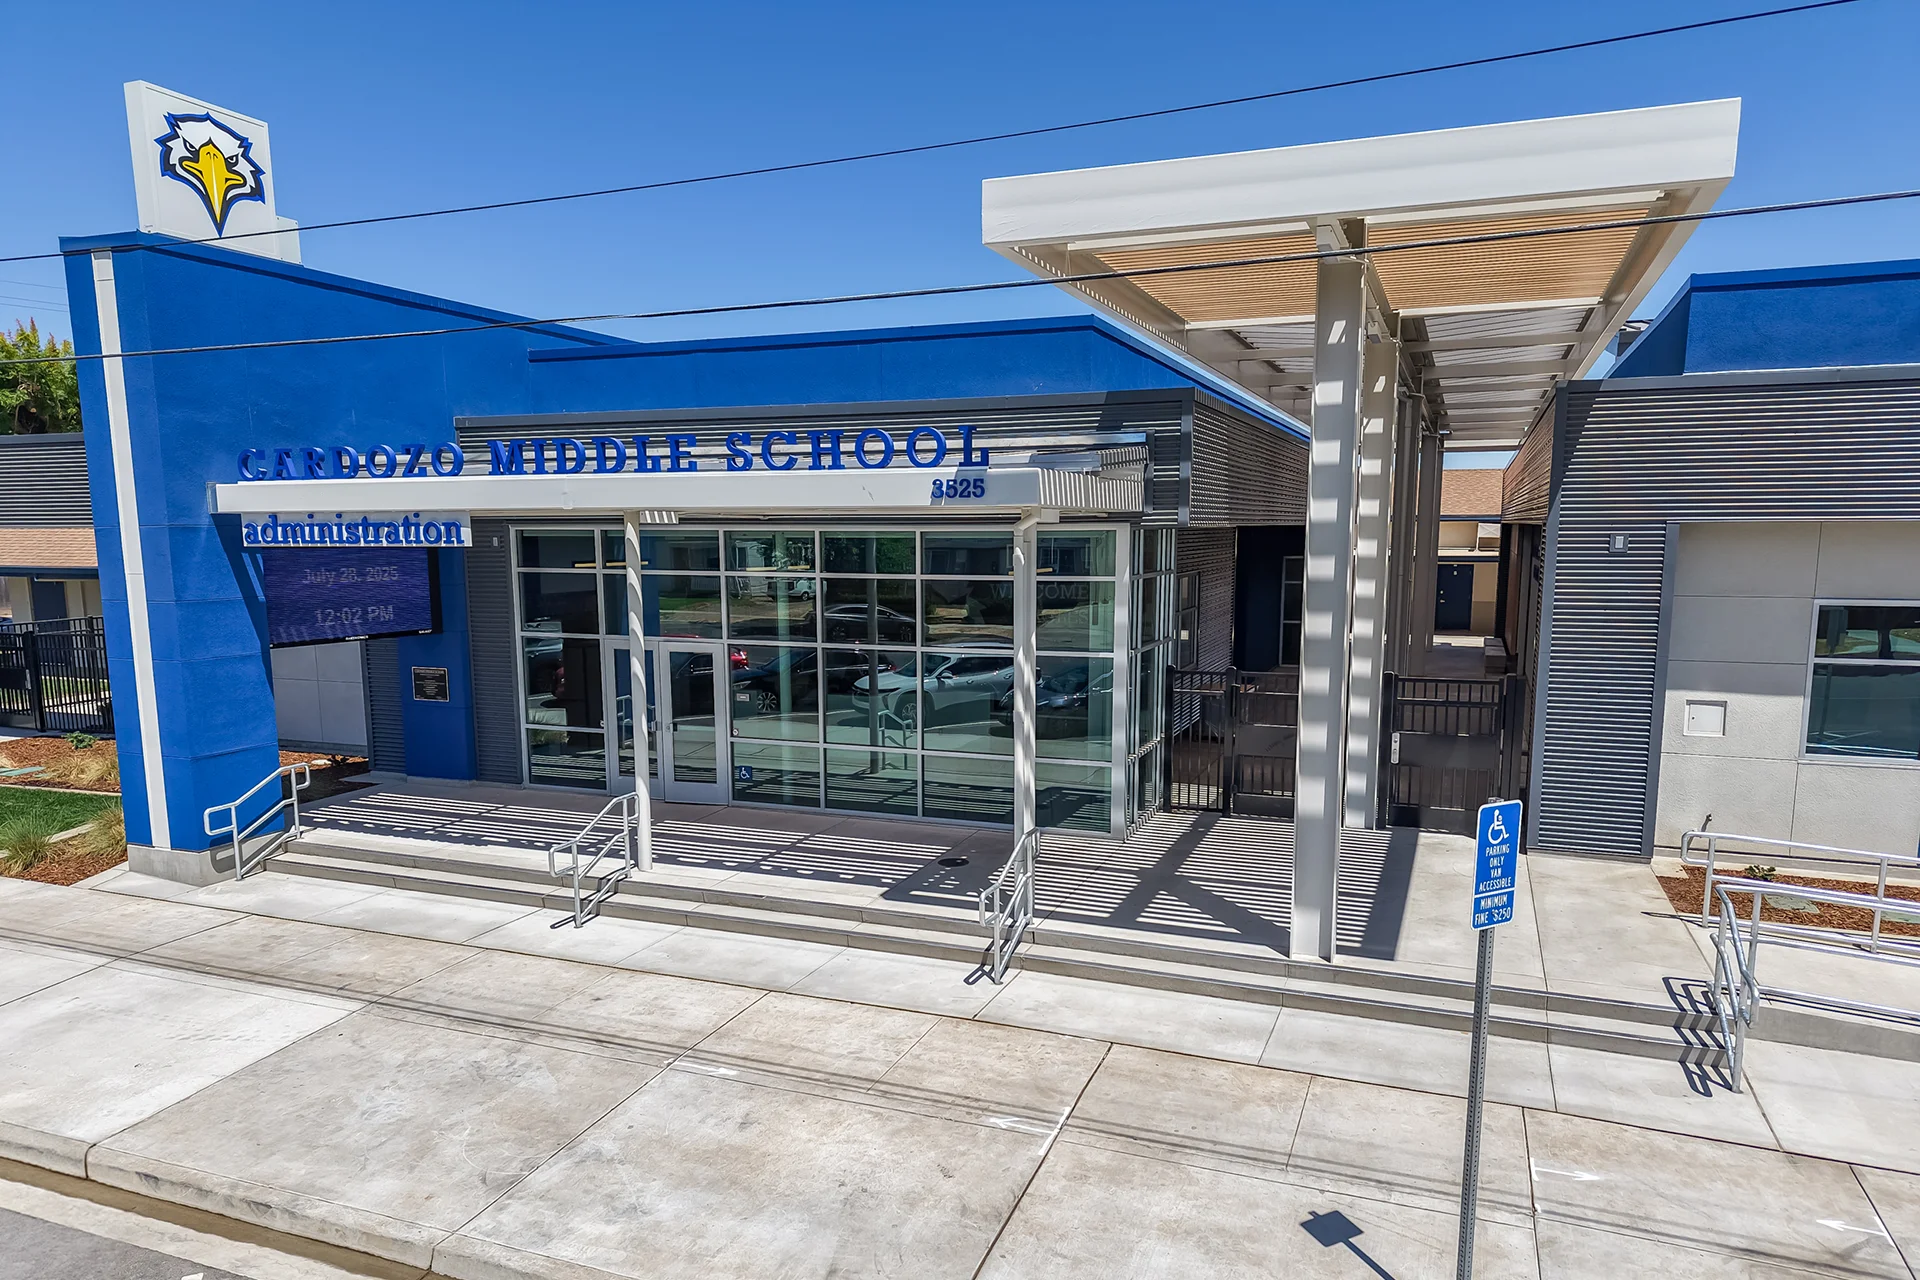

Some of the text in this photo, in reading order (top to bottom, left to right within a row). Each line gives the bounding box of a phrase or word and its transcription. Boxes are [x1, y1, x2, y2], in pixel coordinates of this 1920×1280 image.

[237, 425, 990, 481] CARDOZO MIDDLE SCHOOL
[931, 478, 986, 499] 3525
[243, 512, 465, 546] administration
[302, 567, 336, 586] July
[366, 566, 399, 582] 2025
[314, 604, 394, 626] 12:02 PM
[1485, 843, 1510, 857] PARKING
[1489, 856, 1505, 868] ONLY
[1490, 867, 1502, 879] VAN
[1479, 876, 1512, 892] ACCESSIBLE
[1480, 894, 1508, 910] MINIMUM
[1475, 907, 1511, 926] FINE $250
